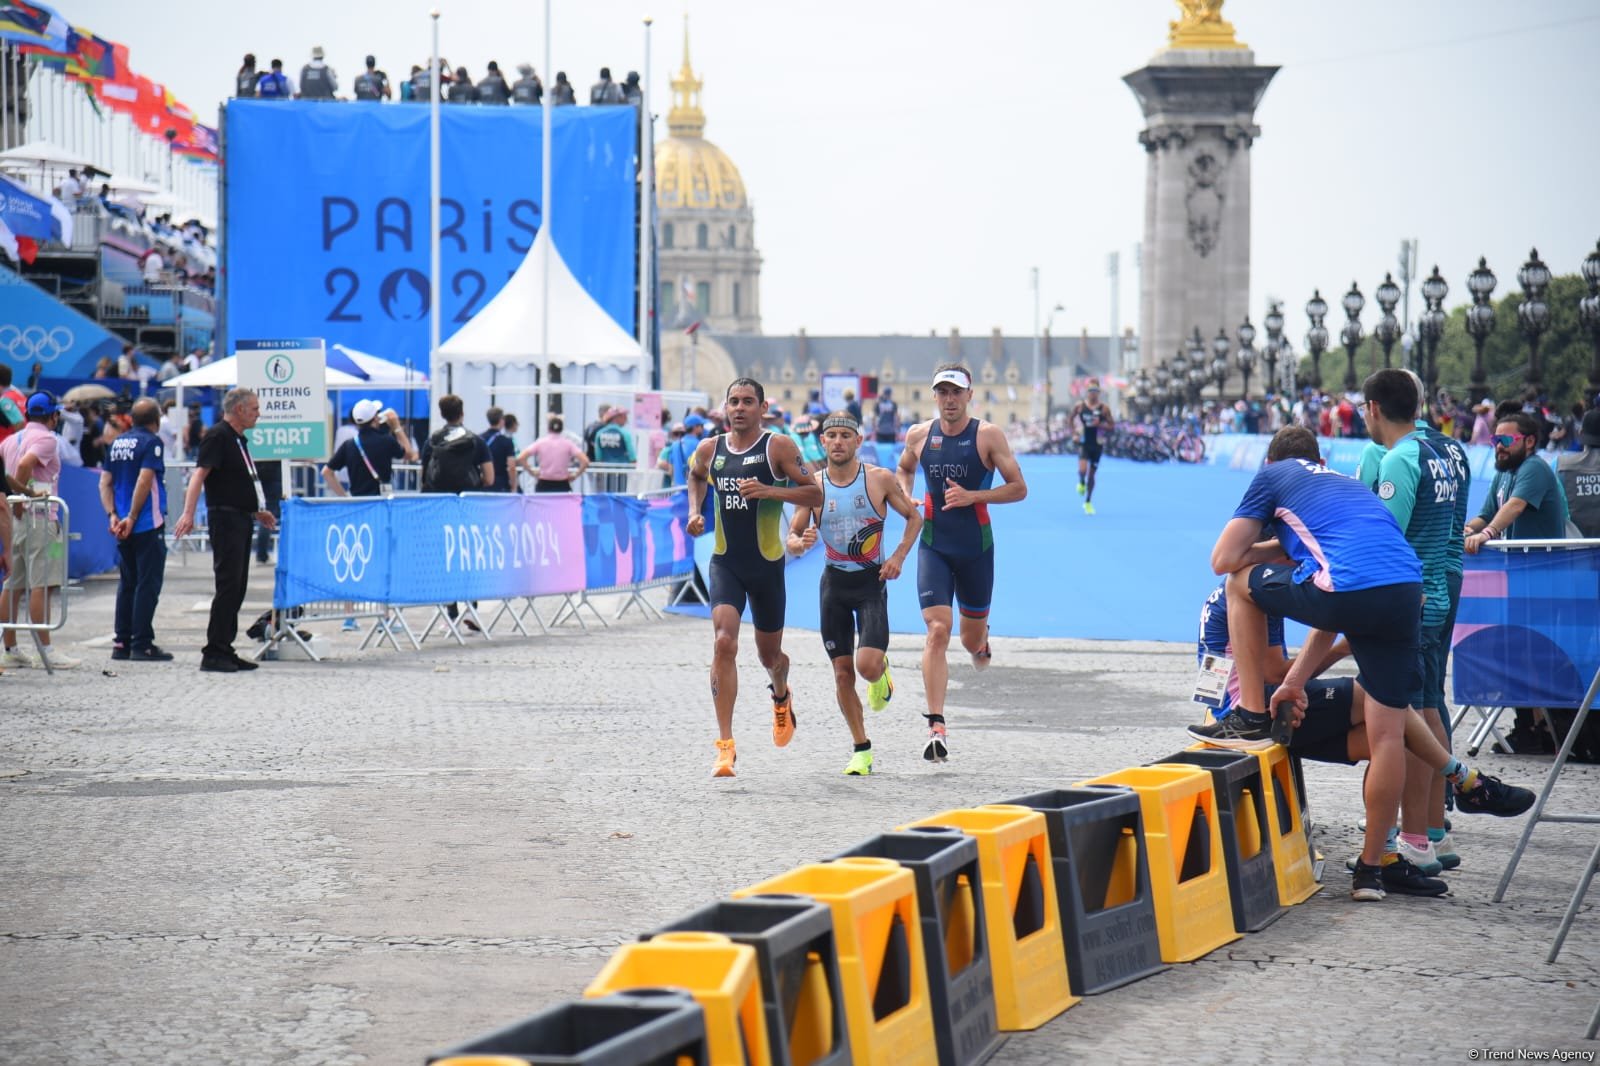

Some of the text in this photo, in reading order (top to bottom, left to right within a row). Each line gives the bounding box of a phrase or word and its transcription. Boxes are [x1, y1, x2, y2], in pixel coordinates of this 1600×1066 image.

[324, 267, 520, 323] 202
[249, 387, 311, 397] ITTERING
[266, 401, 296, 410] AREA
[252, 427, 311, 445] START
[929, 464, 968, 478] PEVTSOV
[725, 495, 748, 510] BRA
[508, 520, 561, 568] 2024
